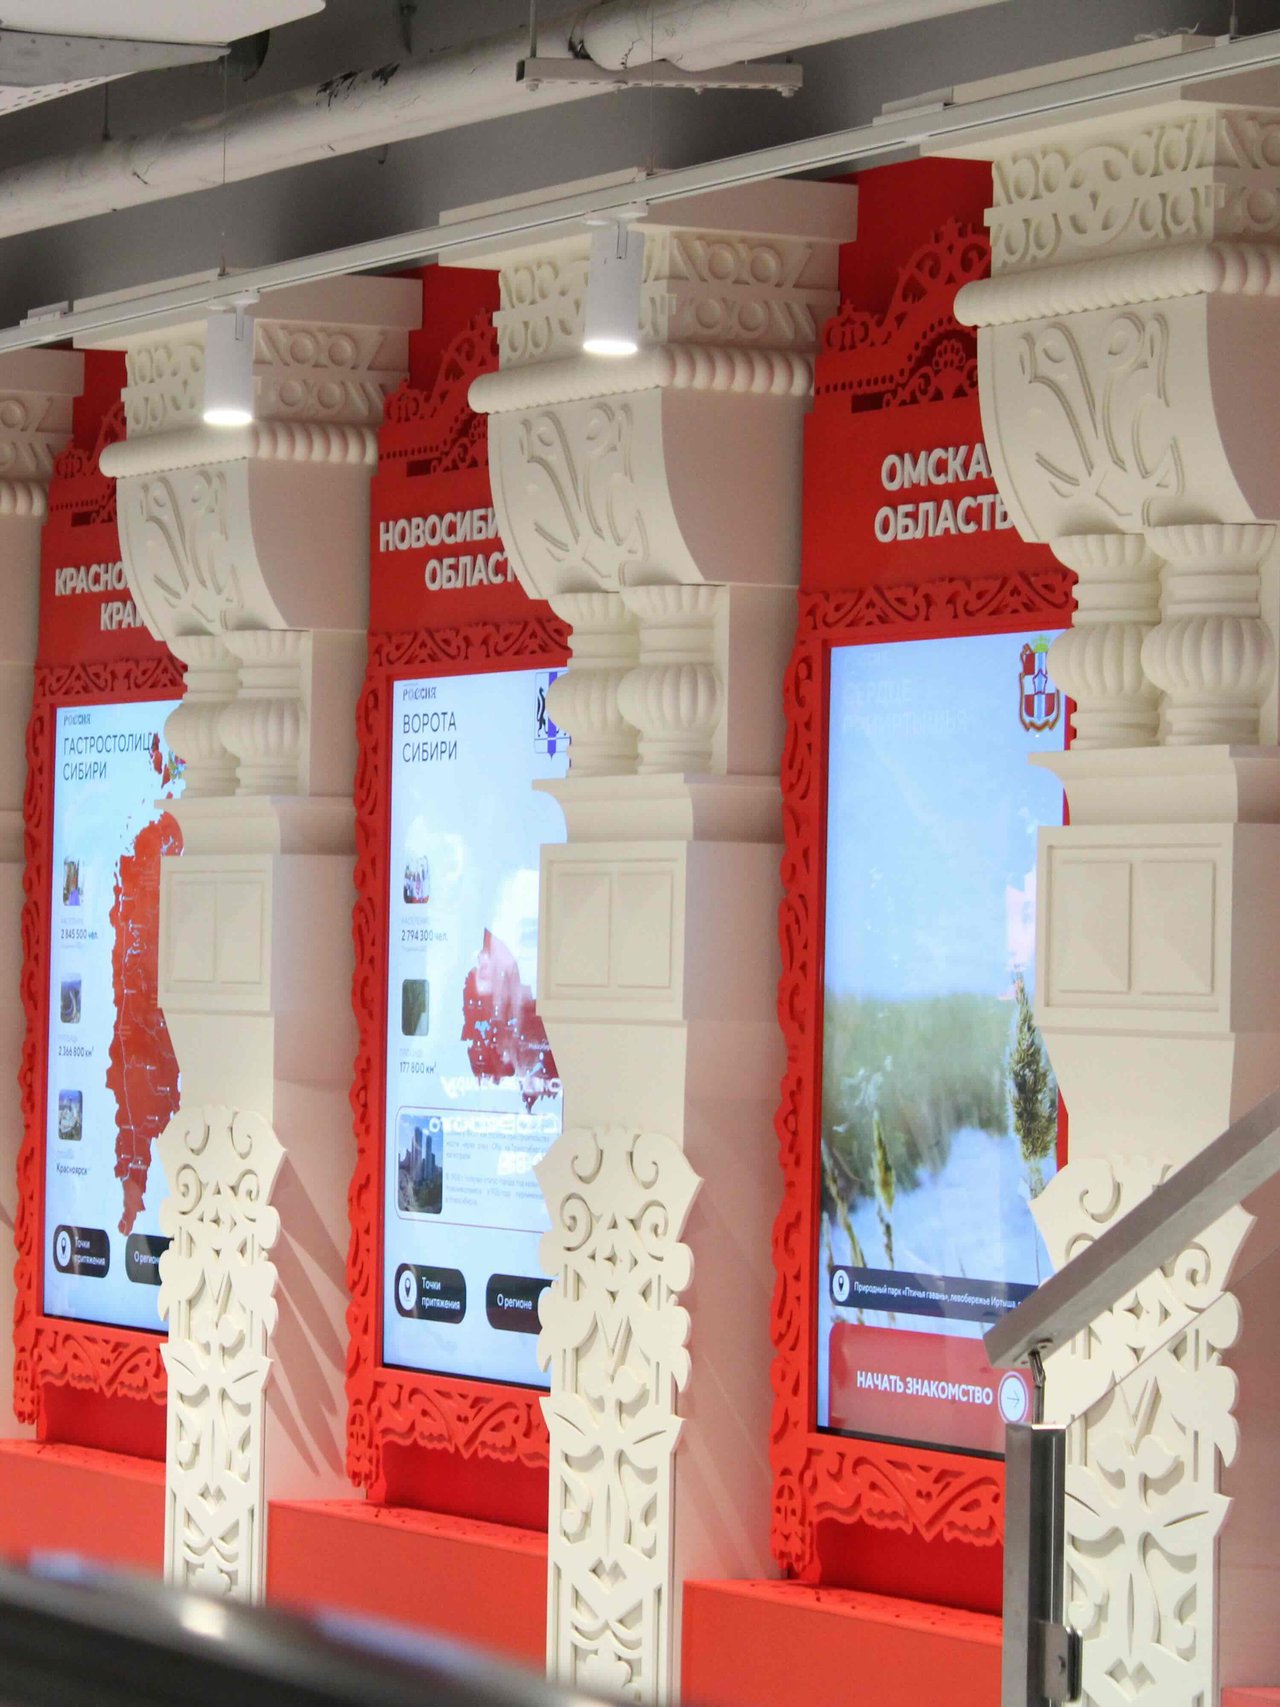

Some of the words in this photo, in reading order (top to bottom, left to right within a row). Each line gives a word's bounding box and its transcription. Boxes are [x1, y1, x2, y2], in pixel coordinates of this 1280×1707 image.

[881, 443, 993, 491] ОМСКА
[875, 493, 1014, 543] ОБЛАСТЬ
[55, 561, 129, 596] КРАСНО
[403, 687, 437, 701] РОССИЯ
[403, 711, 457, 734] ВОРОТА
[402, 740, 458, 763] СИБИРИ
[63, 761, 107, 781] СИБИРИ
[57, 1163, 88, 1176] Красноярск
[422, 1277, 441, 1290] Точки
[854, 1281, 887, 1296] Природный
[421, 1296, 461, 1310] притяжения
[497, 1293, 504, 1306] О
[504, 1297, 532, 1310] регионе
[856, 1370, 904, 1393] НАЧАТЬ
[906, 1376, 994, 1406] ЗНАКОМСТВО
